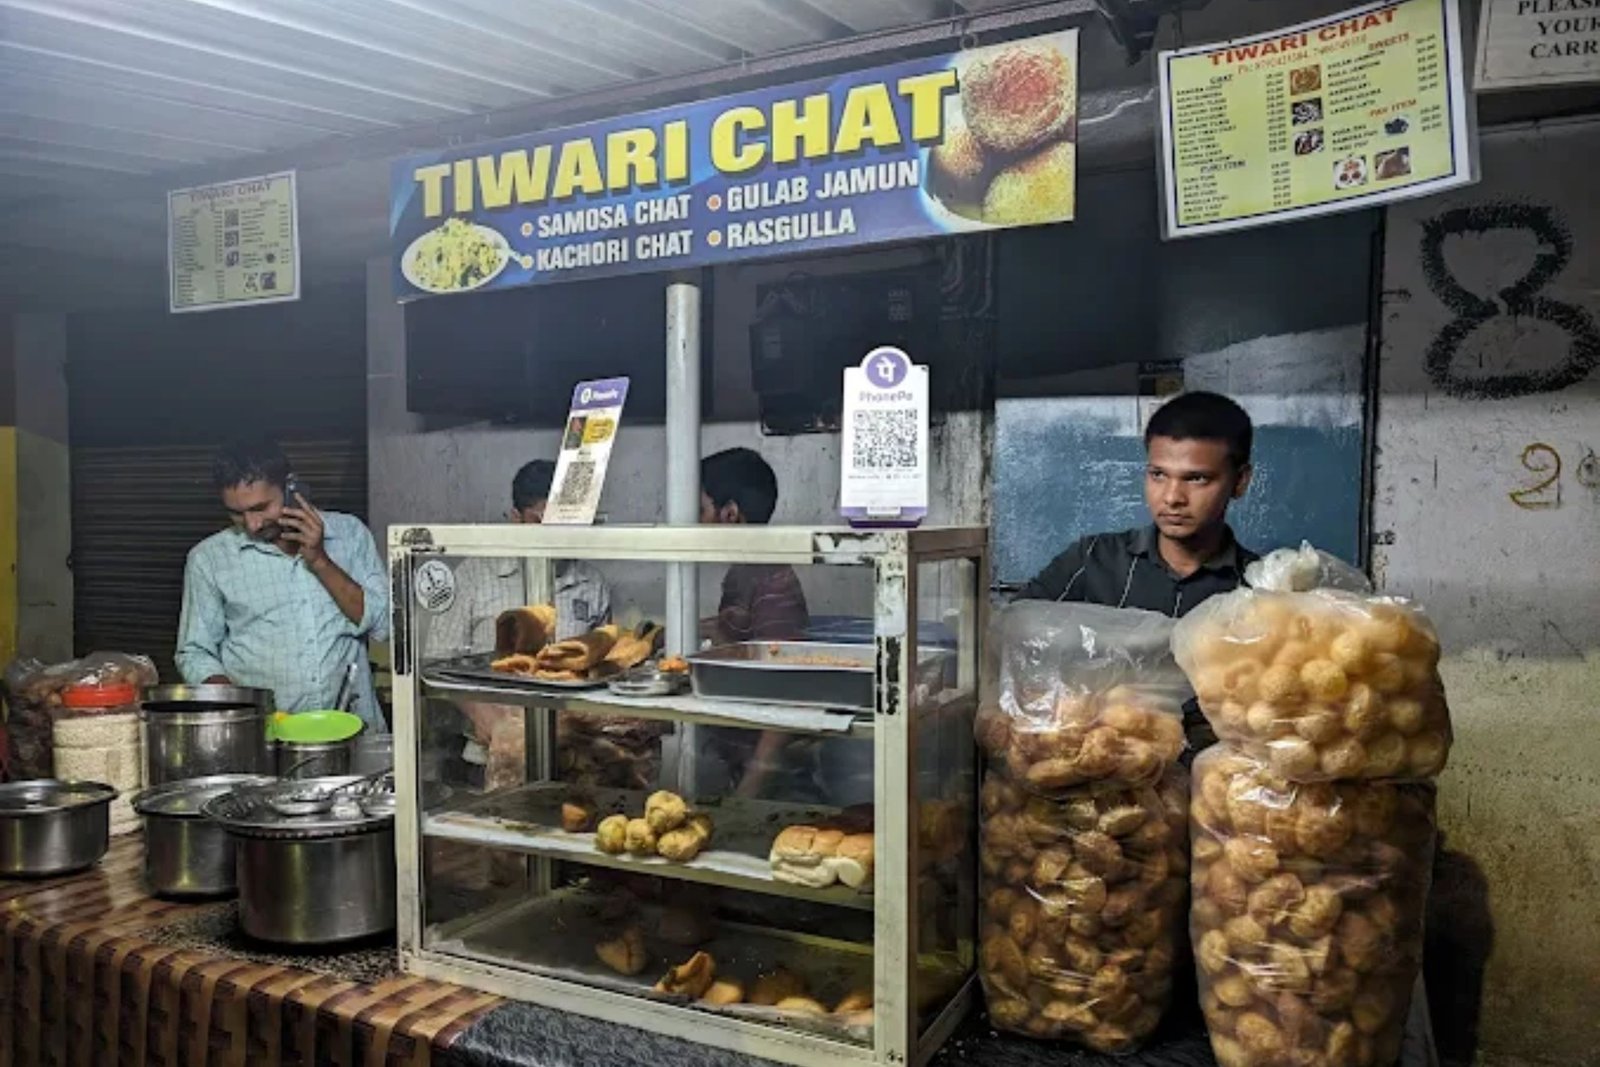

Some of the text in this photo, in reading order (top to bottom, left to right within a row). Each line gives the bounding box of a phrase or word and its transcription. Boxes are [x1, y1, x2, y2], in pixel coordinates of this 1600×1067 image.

[1518, 0, 1600, 16] PLEAS
[1208, 33, 1308, 66] TIWARI
[1318, 7, 1397, 41] CHAT
[414, 69, 957, 218] TIWARI CHAT
[727, 159, 919, 212] GULAB JAMUN
[538, 195, 692, 238] SAMOSA CHAT
[727, 208, 856, 249] RASGULLA
[537, 230, 693, 271] KACHORI CHAT
[1419, 202, 1600, 400] 8
